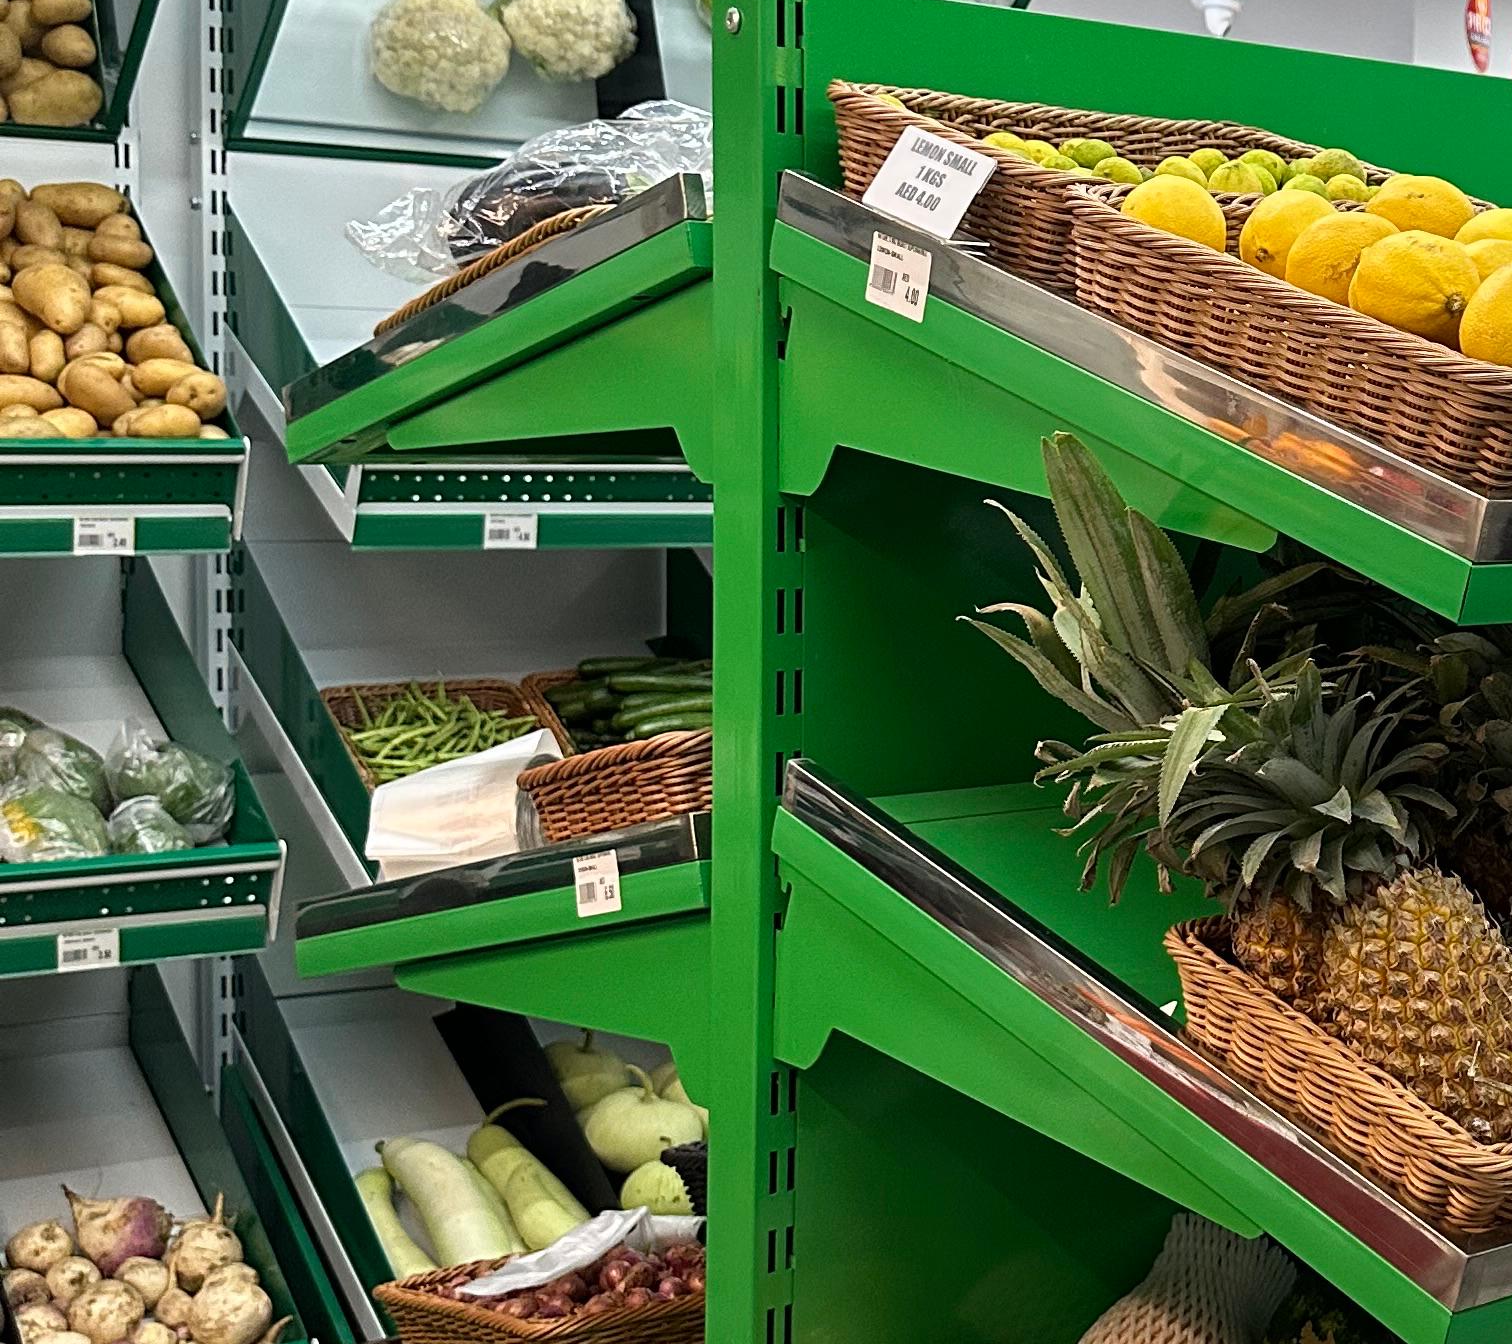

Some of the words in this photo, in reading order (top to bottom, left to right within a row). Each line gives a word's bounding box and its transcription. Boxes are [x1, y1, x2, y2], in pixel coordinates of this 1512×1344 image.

[911, 136, 947, 165] LEMON
[943, 151, 979, 177] SMALL
[915, 165, 925, 180] 1
[921, 167, 947, 188] KGS
[895, 181, 919, 202] AED
[915, 191, 942, 212] 4.00
